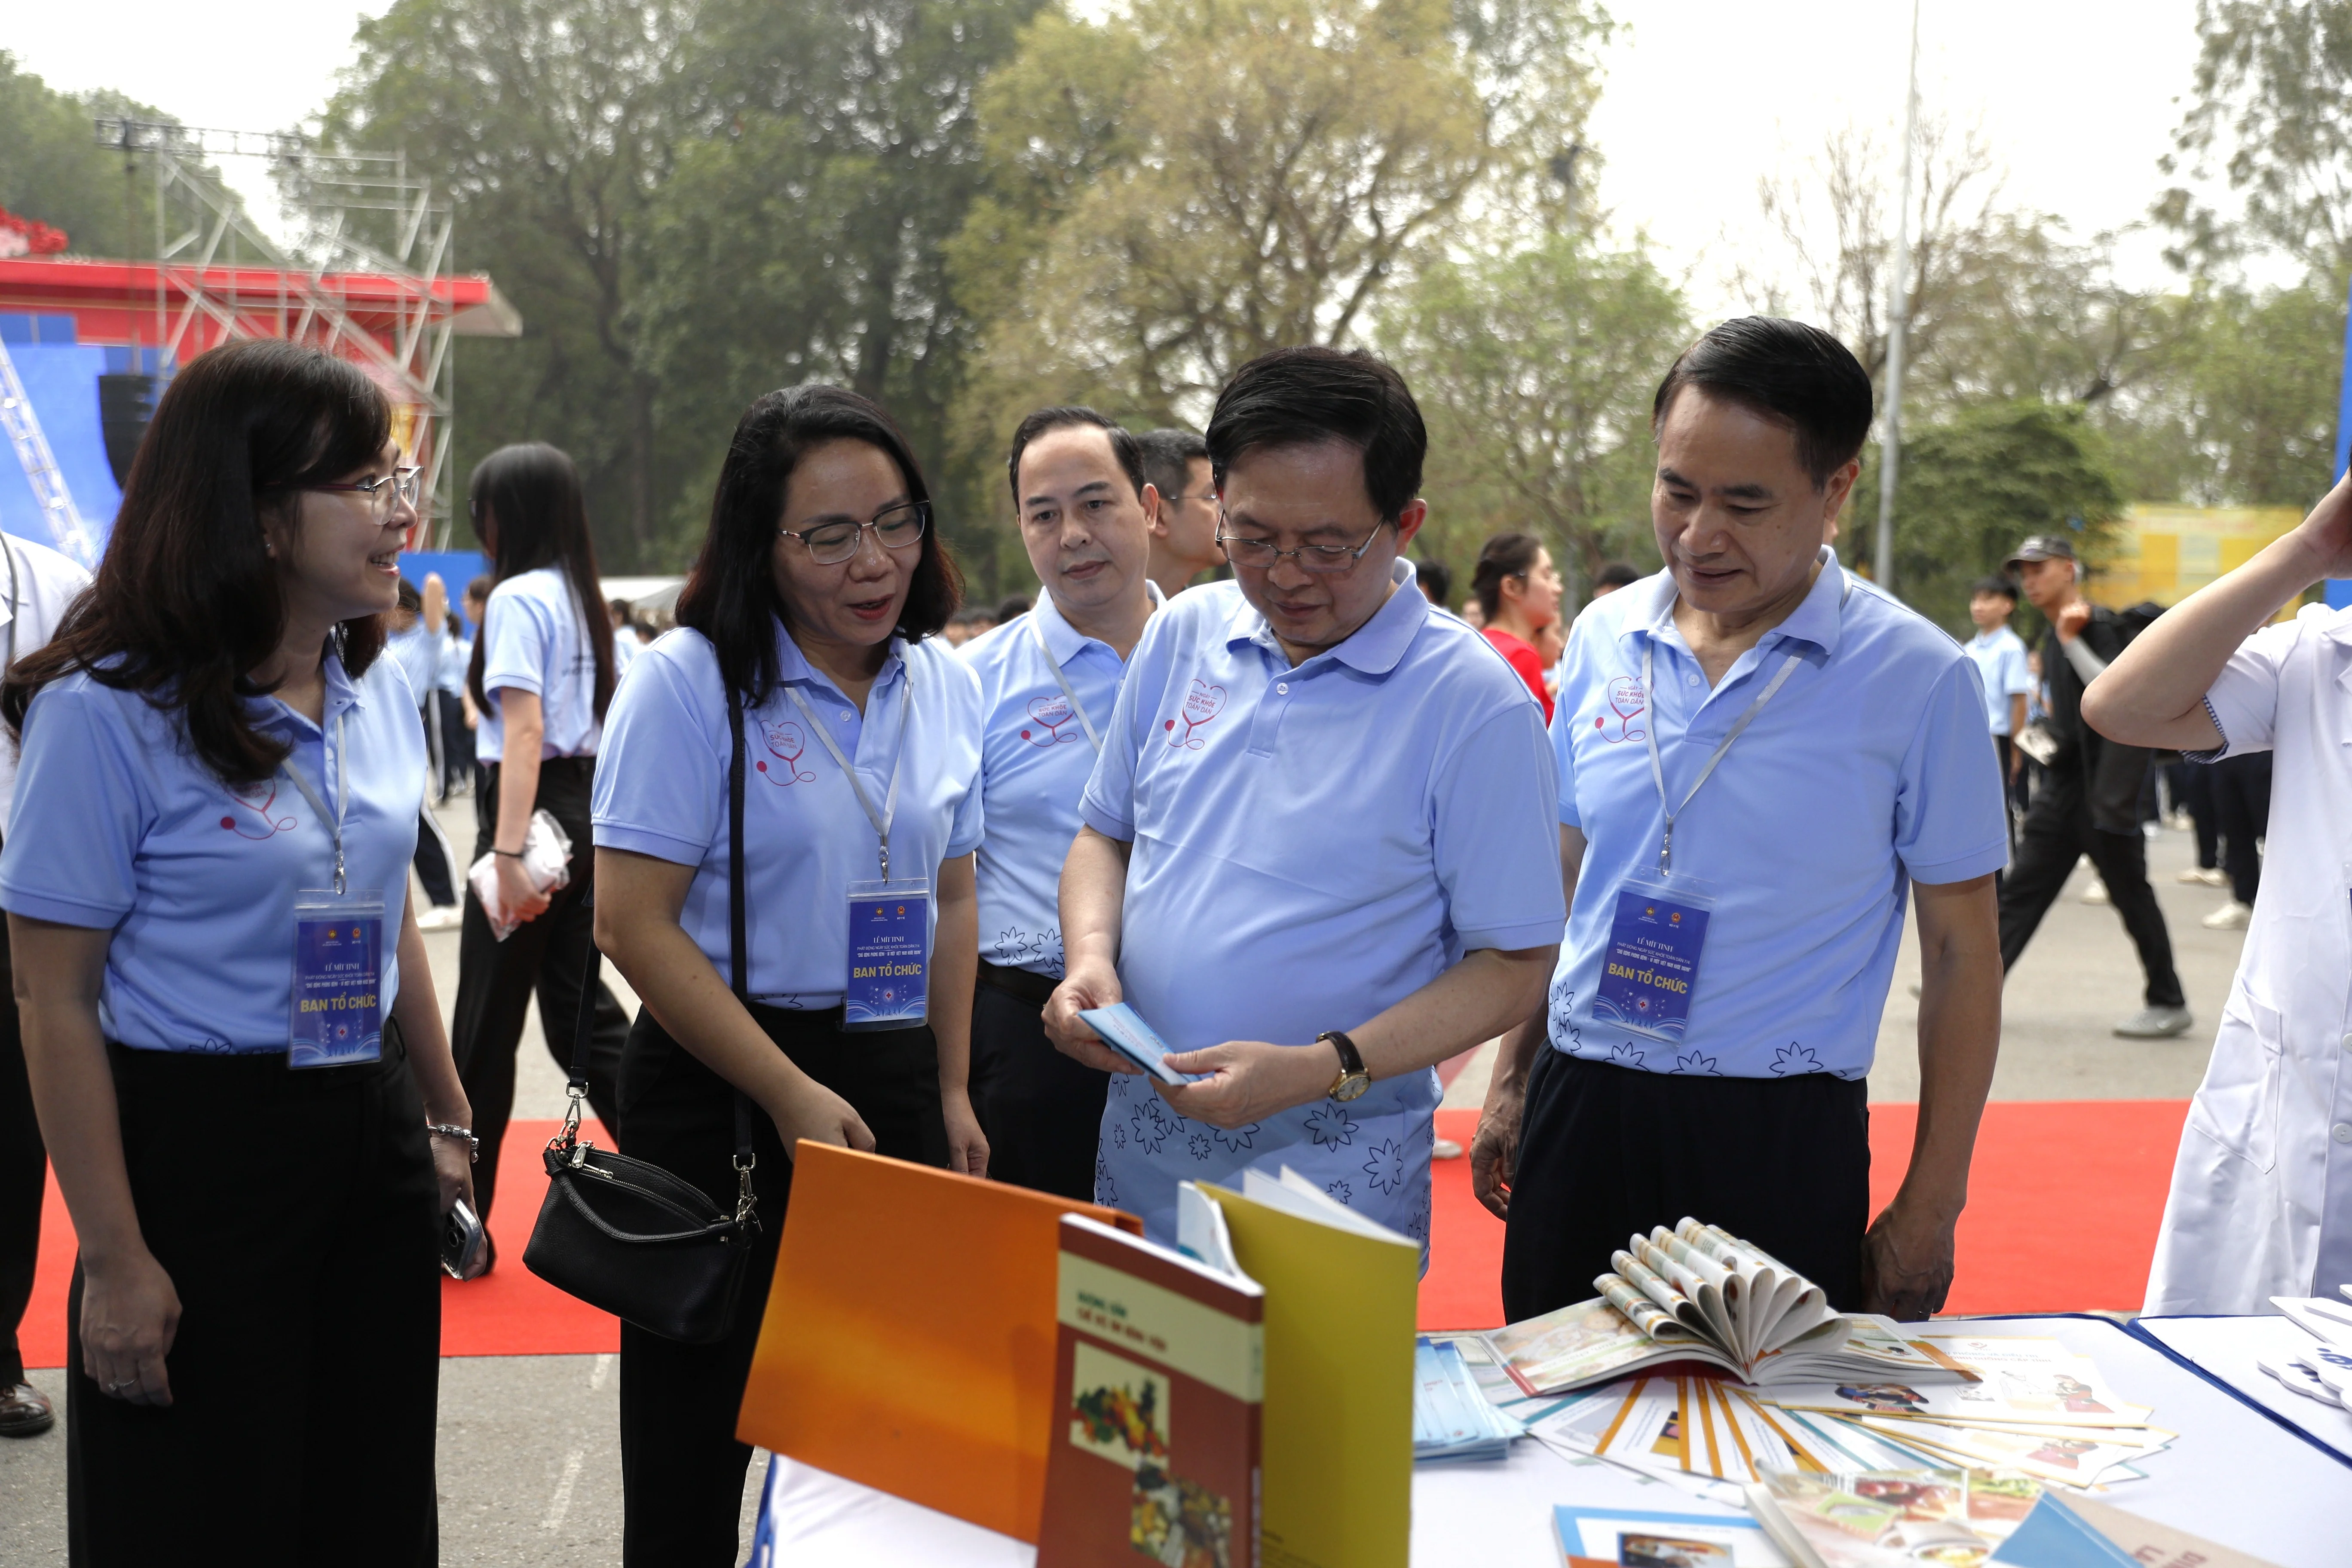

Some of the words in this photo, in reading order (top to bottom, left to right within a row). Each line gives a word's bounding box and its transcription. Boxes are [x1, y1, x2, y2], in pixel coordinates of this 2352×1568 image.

[1186, 701, 1200, 710] TOÀN
[1189, 695, 1200, 703] SỨC
[1200, 700, 1216, 708] KHỎE
[1659, 943, 1673, 952] TINH
[854, 967, 876, 978] BAN
[879, 961, 892, 977] TỔ
[894, 962, 922, 976] CHỨC
[1608, 963, 1635, 980] BAN
[1637, 968, 1654, 984] TỔ
[1654, 976, 1687, 994] CHỨC
[301, 999, 328, 1013] BAN
[331, 992, 346, 1010] TỔ
[349, 993, 376, 1009] CHỨC
